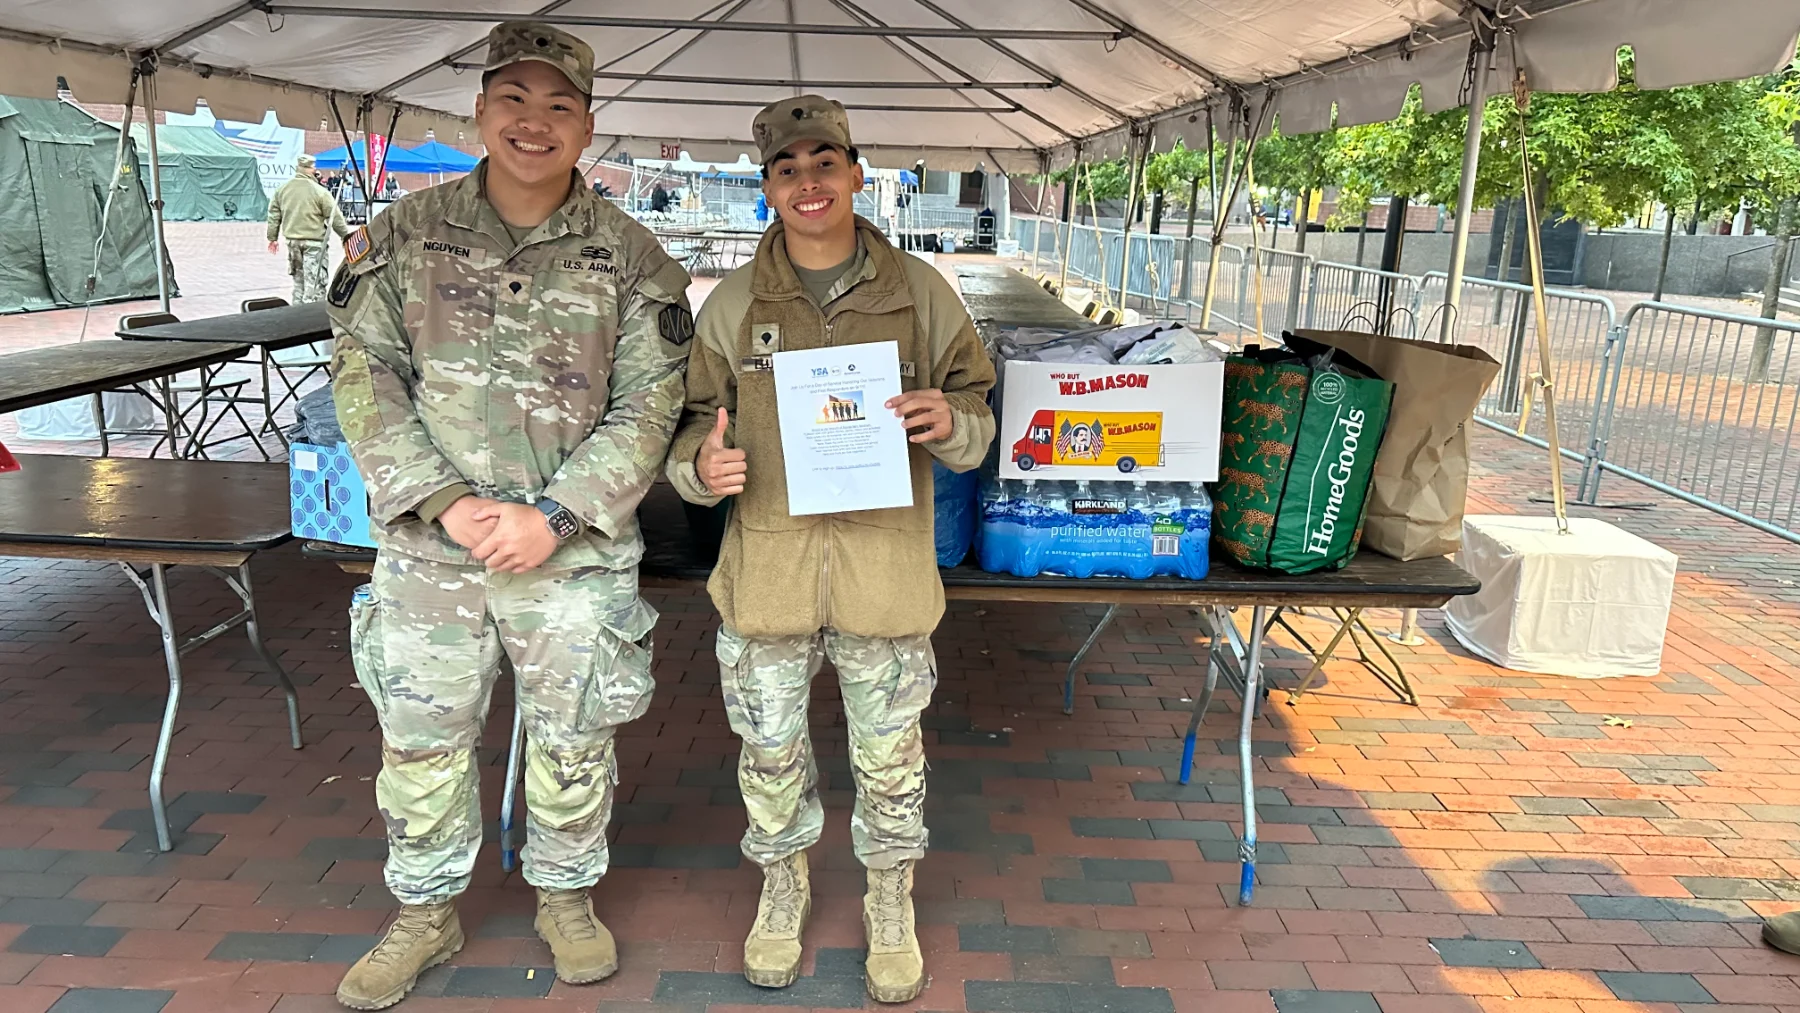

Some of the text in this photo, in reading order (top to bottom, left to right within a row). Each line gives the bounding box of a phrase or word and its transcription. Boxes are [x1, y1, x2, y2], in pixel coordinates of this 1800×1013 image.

[661, 144, 680, 159] EXIT
[423, 241, 470, 258] NGUYEN
[563, 259, 620, 276] U.S. ARMY
[811, 367, 828, 376] YSA
[1307, 408, 1365, 558] HomeGoods
[1075, 500, 1126, 509] KIRKLAND
[1051, 525, 1146, 538] purified water
